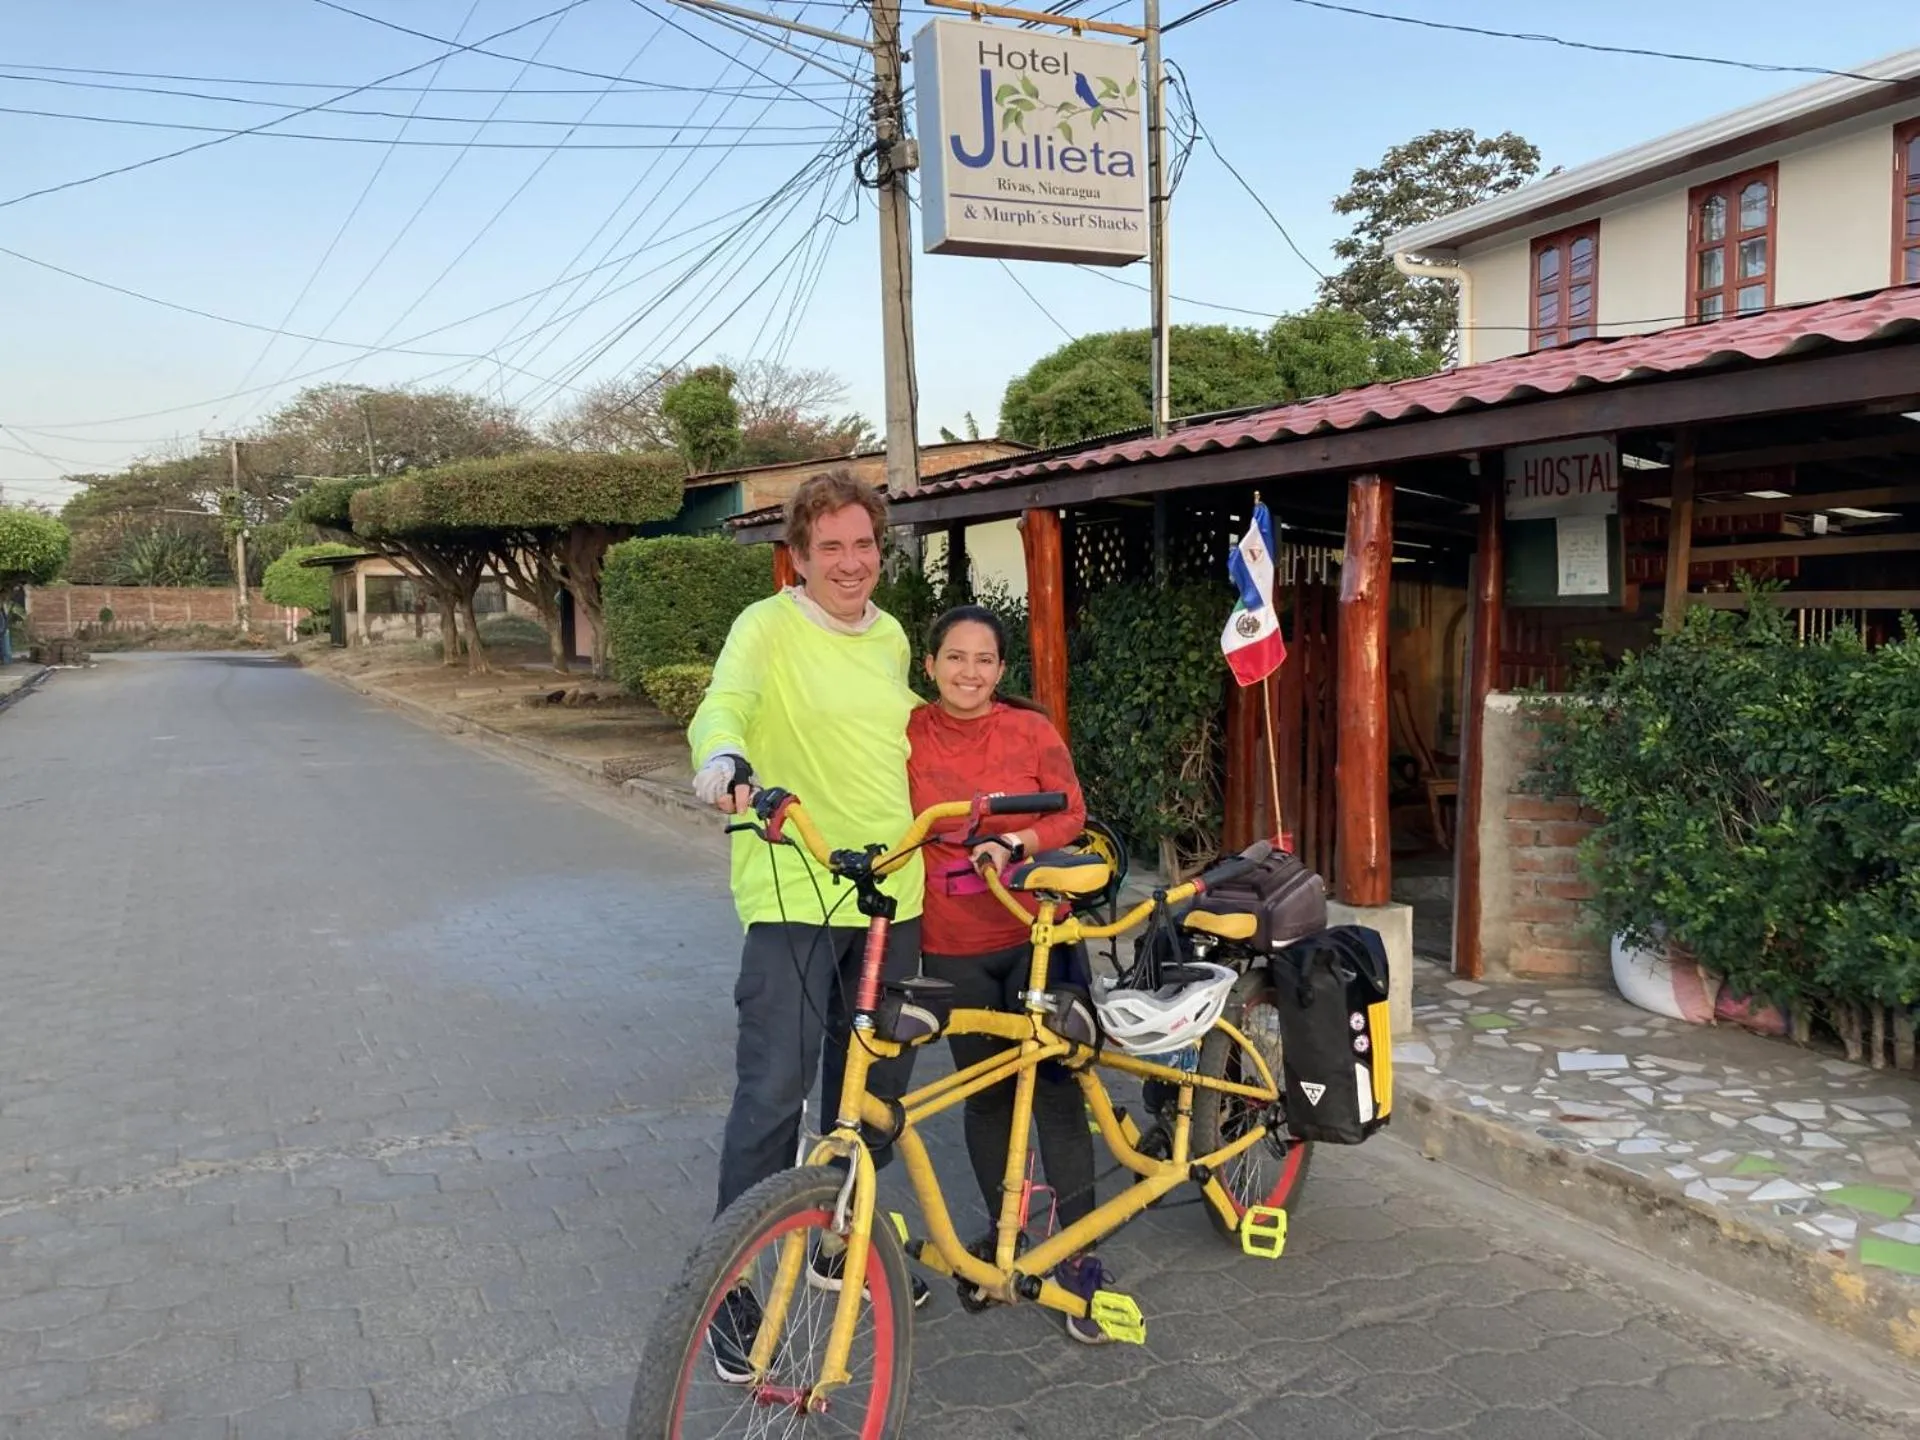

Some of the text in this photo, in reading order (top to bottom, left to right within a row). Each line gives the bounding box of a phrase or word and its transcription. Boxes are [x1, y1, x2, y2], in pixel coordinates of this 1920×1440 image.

[978, 40, 1069, 76] Hotel
[950, 69, 1136, 178] Julieta
[997, 177, 1101, 199] Rivas, Nicaragua
[964, 204, 978, 220] &
[1052, 211, 1086, 228] Surf
[1088, 214, 1139, 231] Shacks
[1523, 451, 1619, 498] HOSTAL
